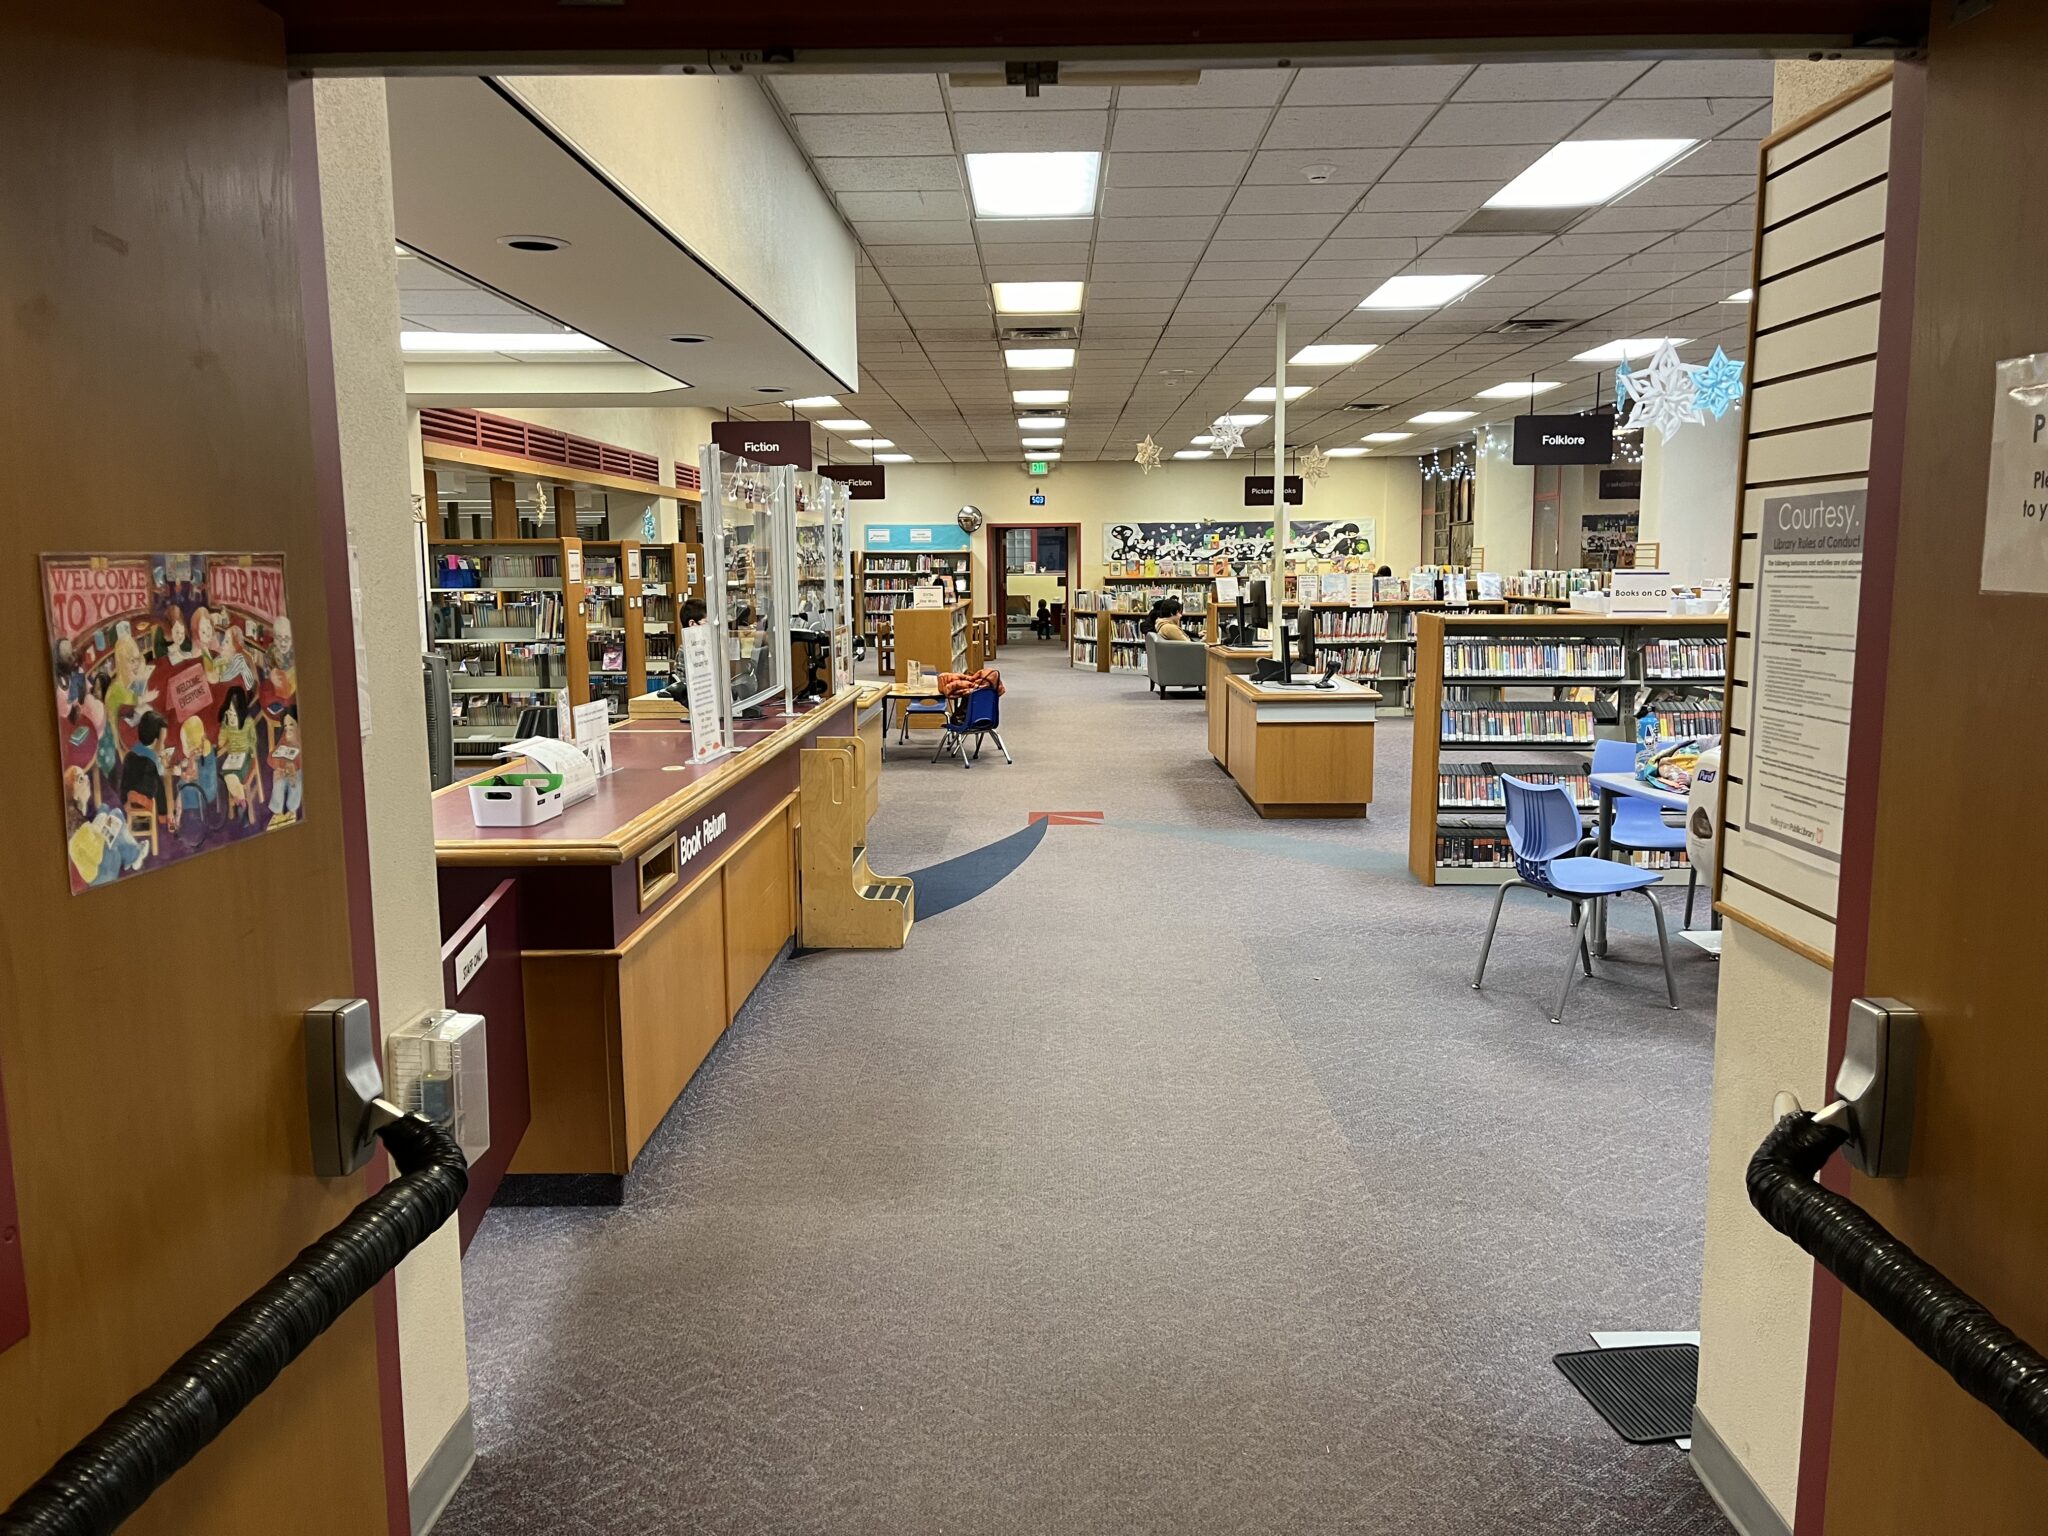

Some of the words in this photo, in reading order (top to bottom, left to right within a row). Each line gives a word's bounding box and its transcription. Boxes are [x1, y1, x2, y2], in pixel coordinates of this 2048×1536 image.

[744, 442, 780, 452] Fiction
[1542, 435, 1585, 445] Folklore
[1778, 500, 1860, 534] Courtesy.
[2023, 499, 2035, 518] to
[1773, 538, 1797, 552] Library
[1798, 537, 1816, 549] Rules
[1818, 535, 1826, 549] of
[1826, 534, 1861, 549] Conduct
[51, 568, 147, 592] WELCOME
[209, 567, 282, 618] LIBRARY
[1615, 589, 1640, 597] Books
[1654, 589, 1667, 597] CD
[53, 593, 87, 635] TO
[91, 592, 148, 621] YOUR
[176, 674, 202, 695] WELCOME
[680, 825, 702, 866] Book
[703, 812, 727, 847] Return
